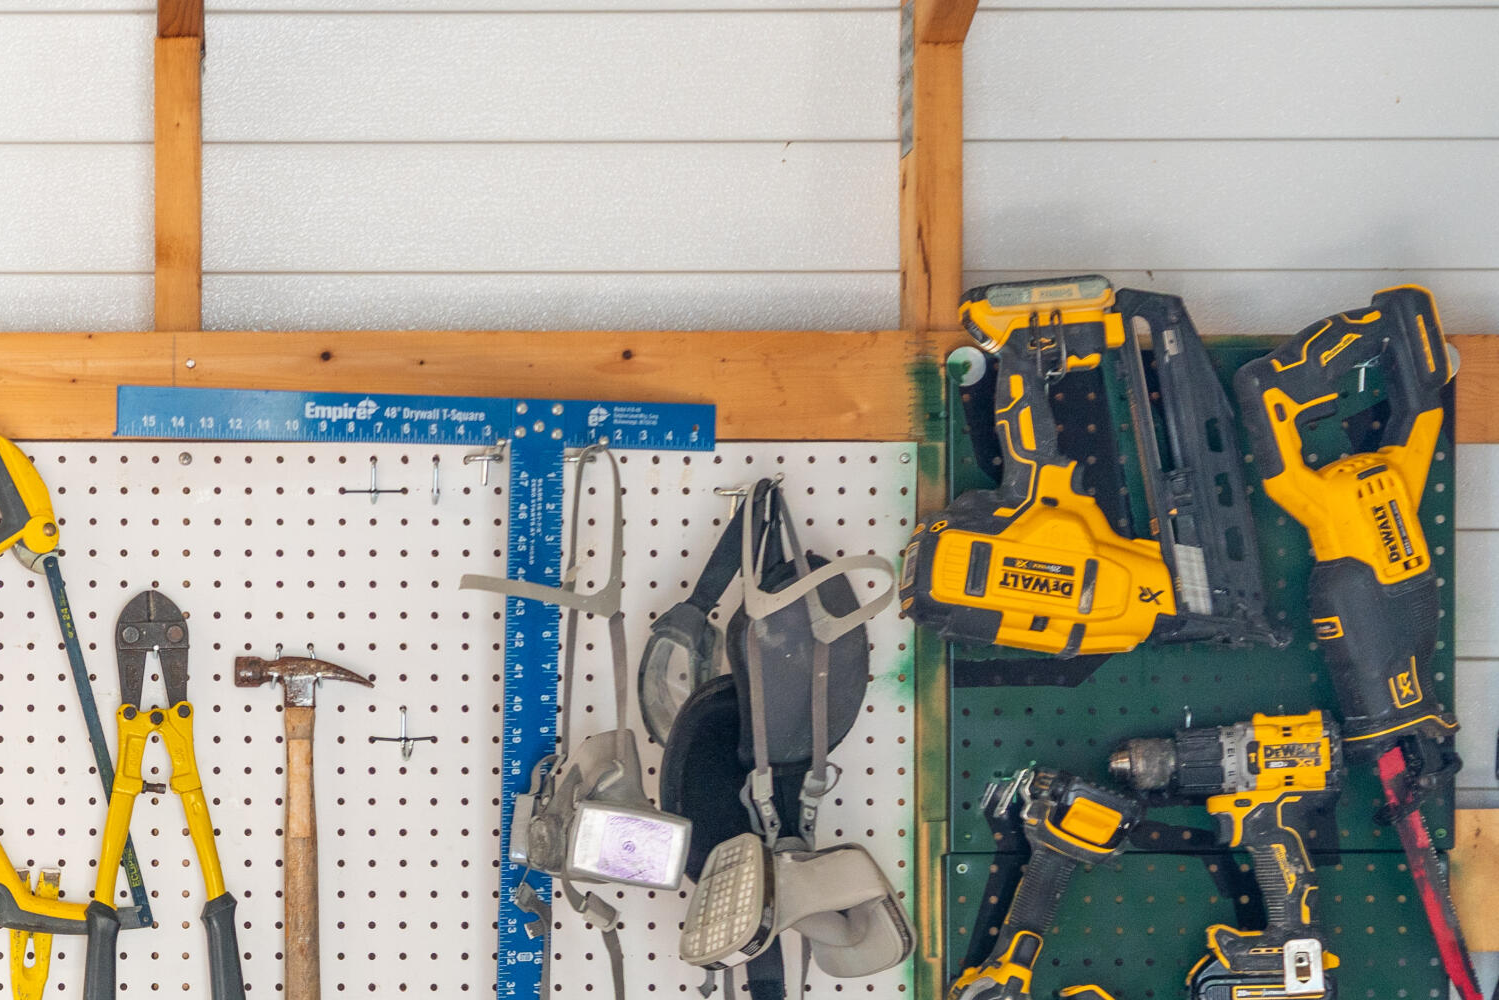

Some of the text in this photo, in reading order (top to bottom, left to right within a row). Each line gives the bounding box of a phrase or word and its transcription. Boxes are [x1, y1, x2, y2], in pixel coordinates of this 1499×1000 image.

[304, 401, 366, 422] Empire
[403, 406, 439, 420] Drywall
[442, 407, 485, 421] T-Square
[142, 415, 492, 436] 15 14 13 12 11 10 9 8 7 6 5 4 3
[589, 428, 698, 442] 1 2 3 4 5
[519, 471, 529, 488] 47
[518, 503, 528, 520] 46
[1373, 506, 1401, 563] DEWALT
[517, 535, 527, 552] 45
[1000, 573, 1074, 597] DEWALT
[515, 600, 525, 616] 43
[514, 632, 524, 648] 42
[514, 663, 523, 679] 41
[1397, 671, 1415, 699] XR
[513, 696, 522, 712] 40
[512, 728, 522, 744] 39
[511, 759, 521, 775] 38
[507, 918, 516, 934] 33
[507, 950, 516, 965] 32
[506, 982, 515, 995] 31
